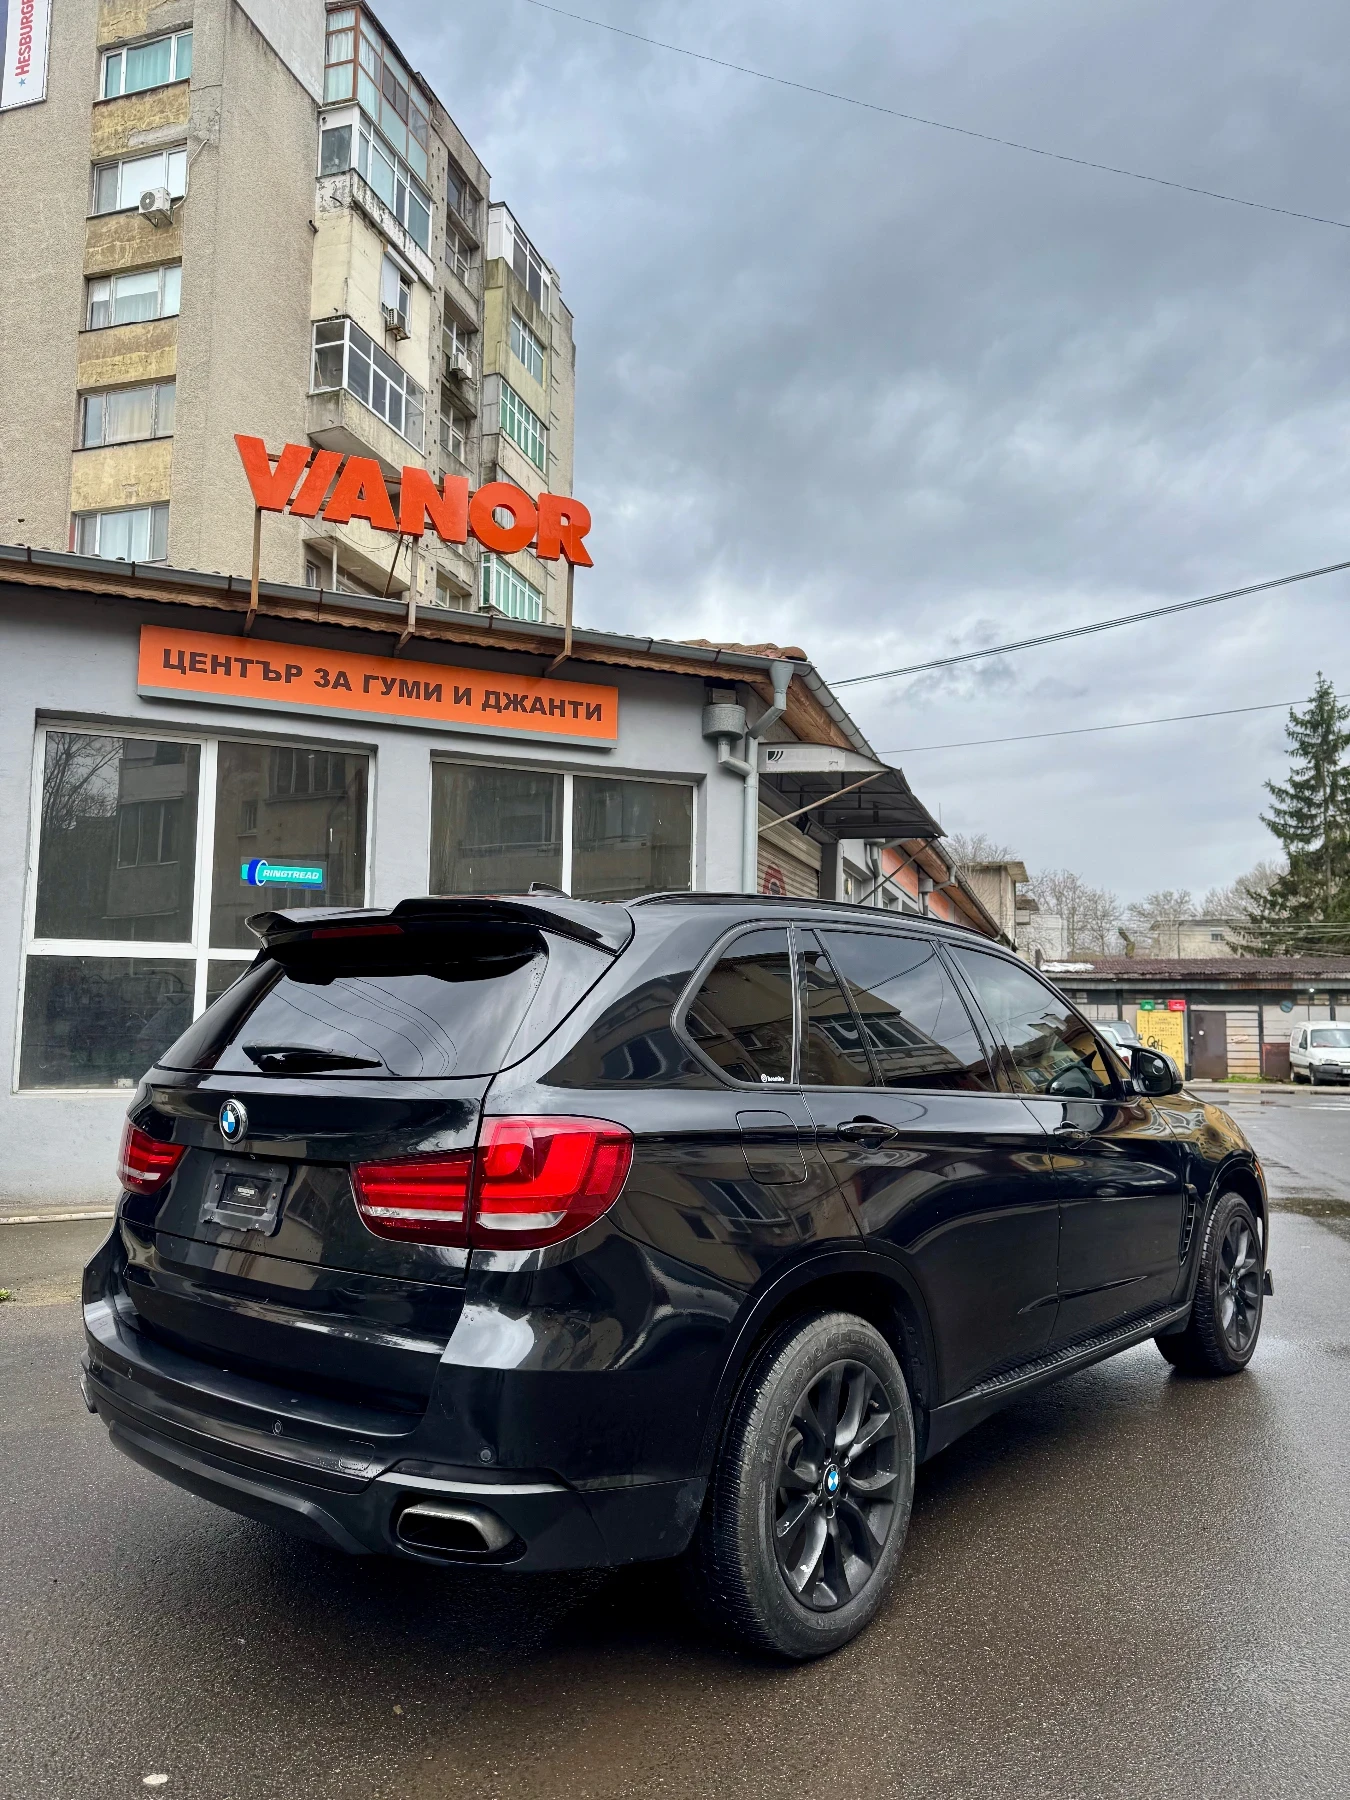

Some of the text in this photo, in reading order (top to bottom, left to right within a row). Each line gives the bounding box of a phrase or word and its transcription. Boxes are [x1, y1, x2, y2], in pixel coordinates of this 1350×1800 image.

[234, 433, 594, 567] VIANOR
[162, 648, 602, 722] ЦЕНТЪР ЗА ГУМИ И ДЖАНТИ
[263, 869, 320, 880] RINGTREAD
